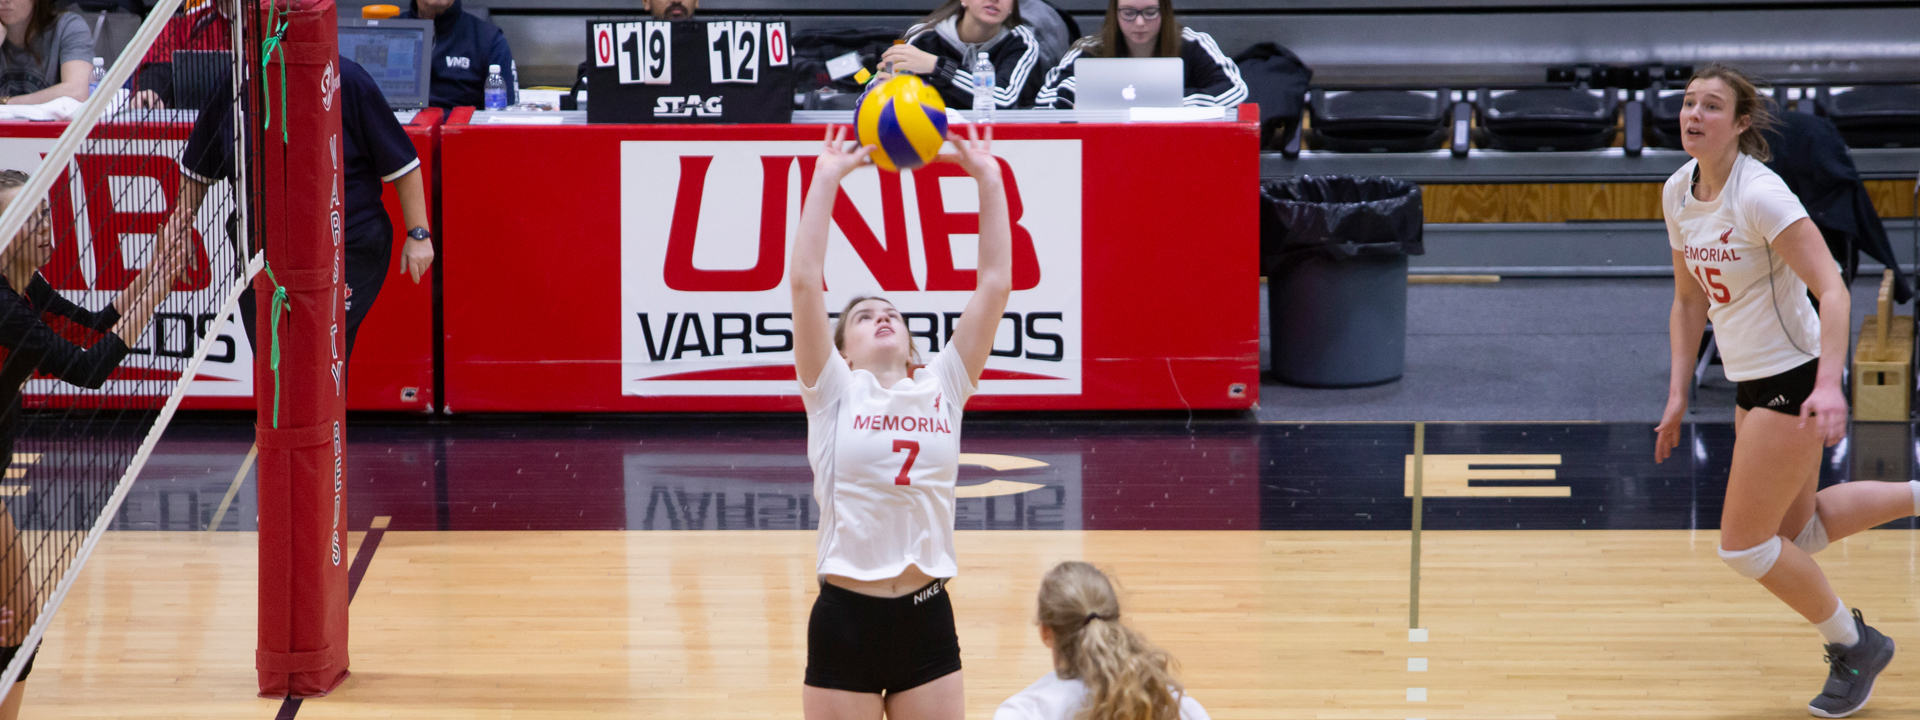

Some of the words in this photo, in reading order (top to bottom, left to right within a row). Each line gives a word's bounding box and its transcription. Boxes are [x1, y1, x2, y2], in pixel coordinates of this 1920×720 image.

[598, 29, 611, 64] 0
[621, 29, 666, 81] 19
[713, 29, 756, 81] 12
[771, 29, 784, 63] 0
[653, 94, 723, 117] STAG
[663, 154, 1041, 292] UNB
[1684, 244, 1741, 262] EMORIAL
[1693, 265, 1731, 304] 15
[636, 311, 842, 362] VARS
[852, 414, 952, 434] MEMORIAL
[892, 438, 921, 486] 7
[913, 581, 940, 606] NIKE
